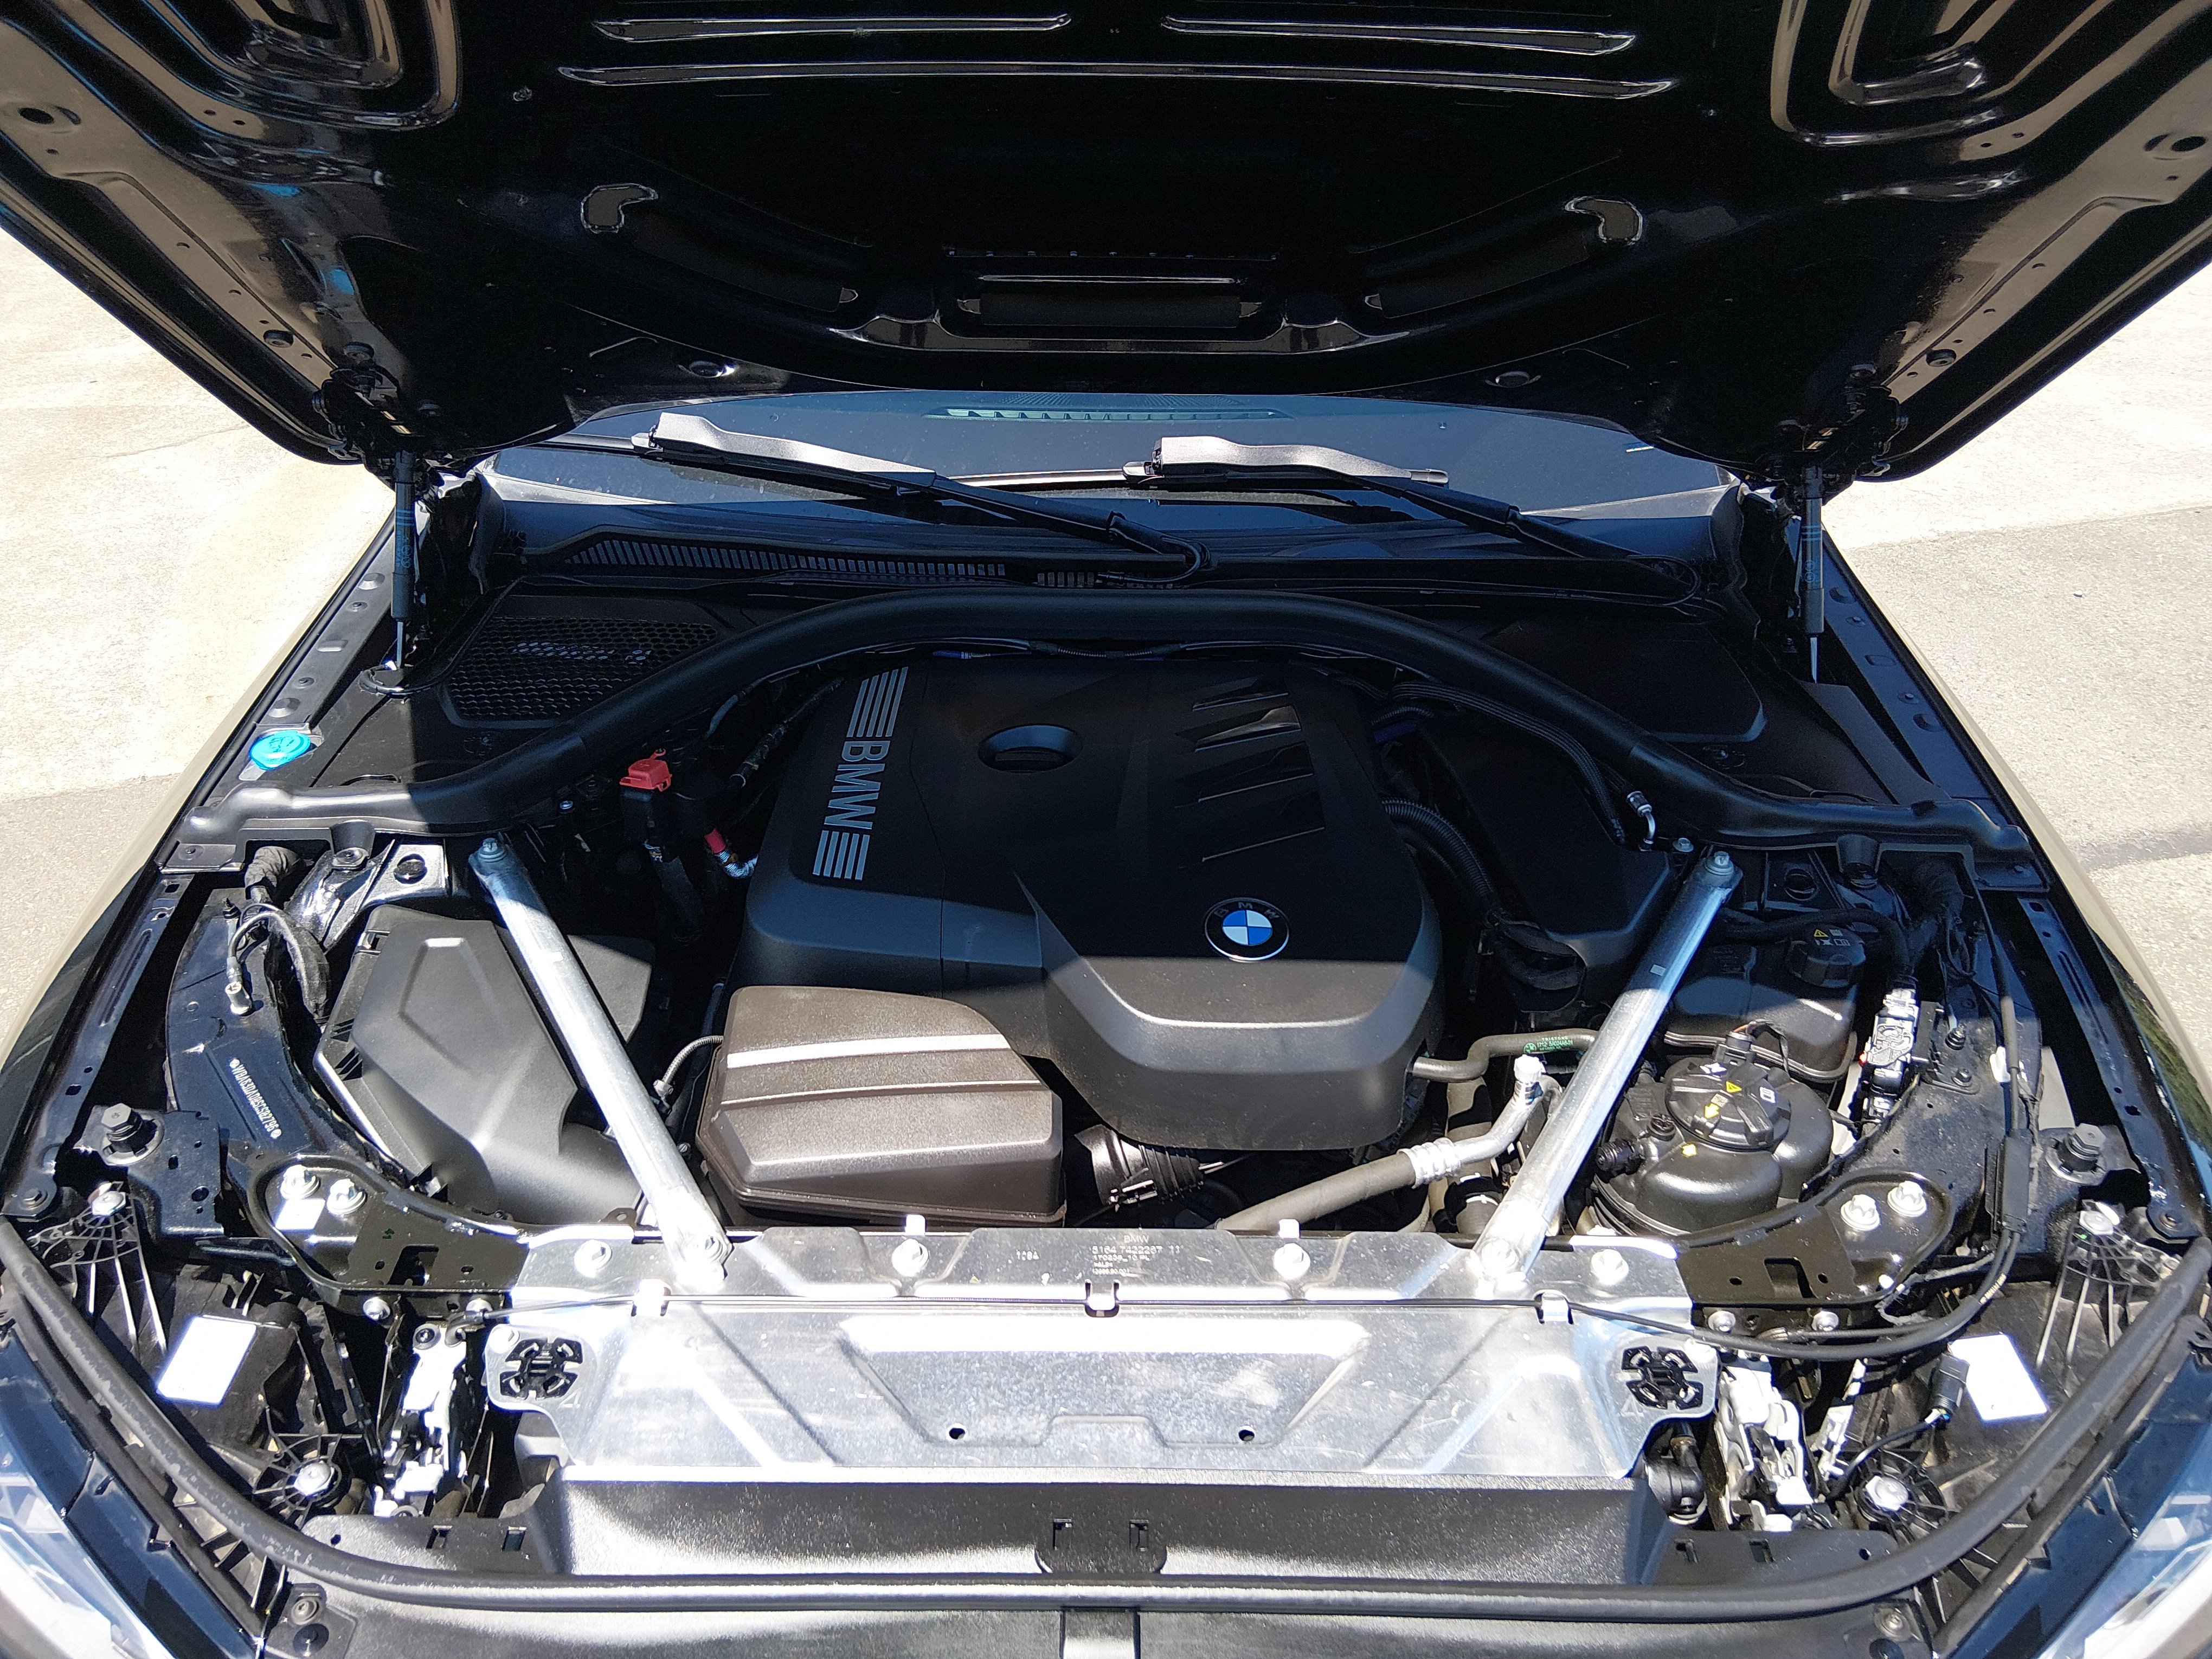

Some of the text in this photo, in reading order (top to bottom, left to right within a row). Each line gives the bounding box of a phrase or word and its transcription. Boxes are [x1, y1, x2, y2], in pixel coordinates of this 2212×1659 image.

[824, 740, 890, 830] BMW
[1214, 902, 1280, 919] BMW
[1123, 1235, 1149, 1243] BMW
